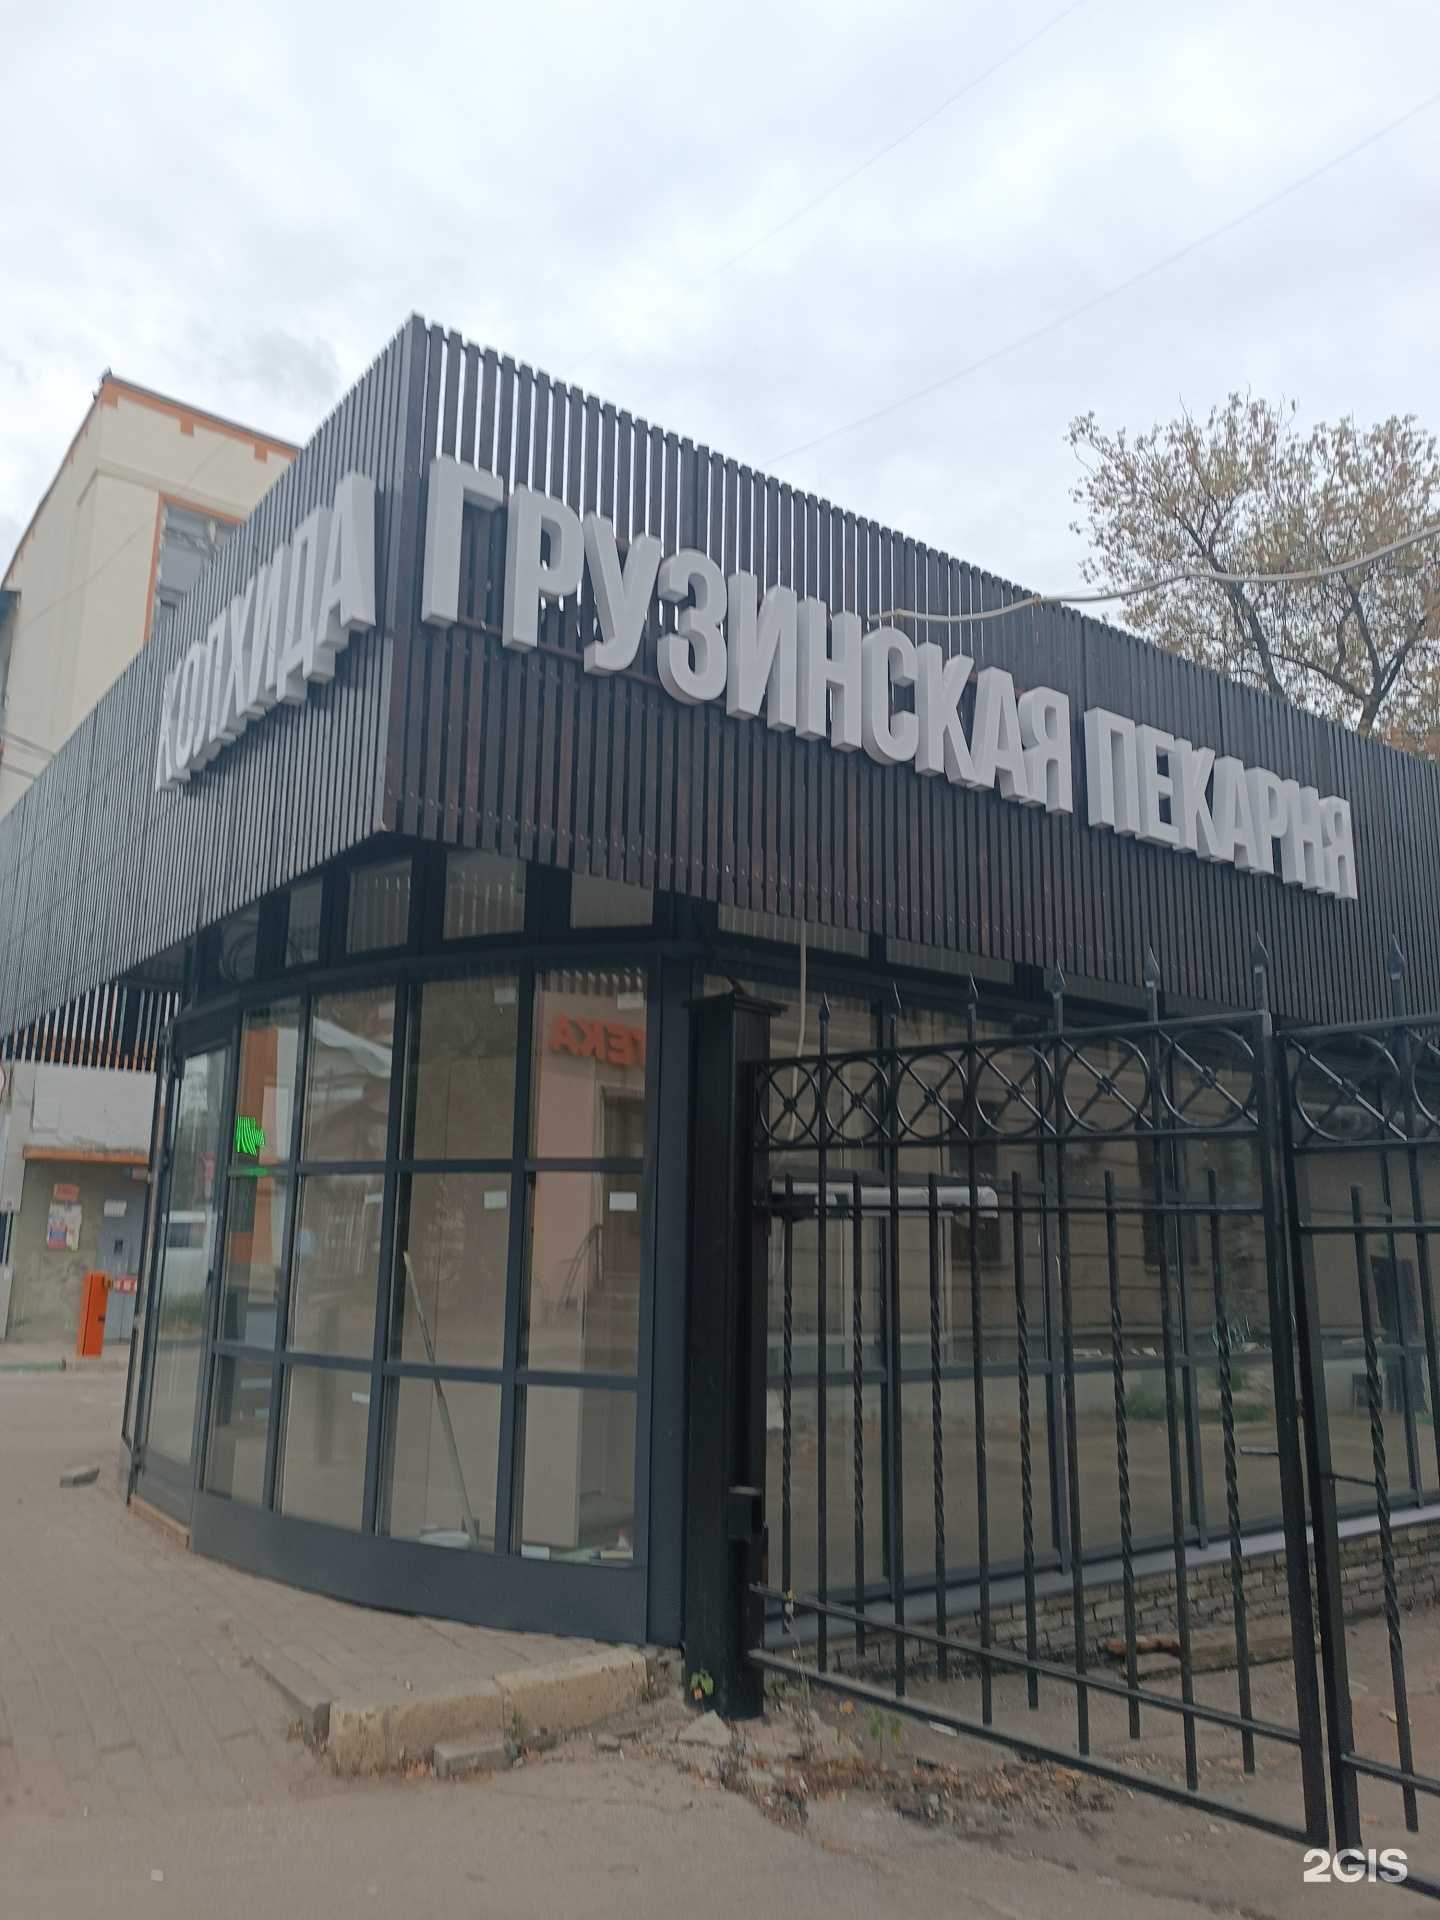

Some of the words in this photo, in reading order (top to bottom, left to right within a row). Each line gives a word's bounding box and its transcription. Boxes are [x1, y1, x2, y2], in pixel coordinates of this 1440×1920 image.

[155, 469, 376, 791] КОЛХИДА
[421, 454, 1074, 815] ГРУЗИНСКАЯ
[1083, 706, 1359, 901] ПЕКАРНЯ
